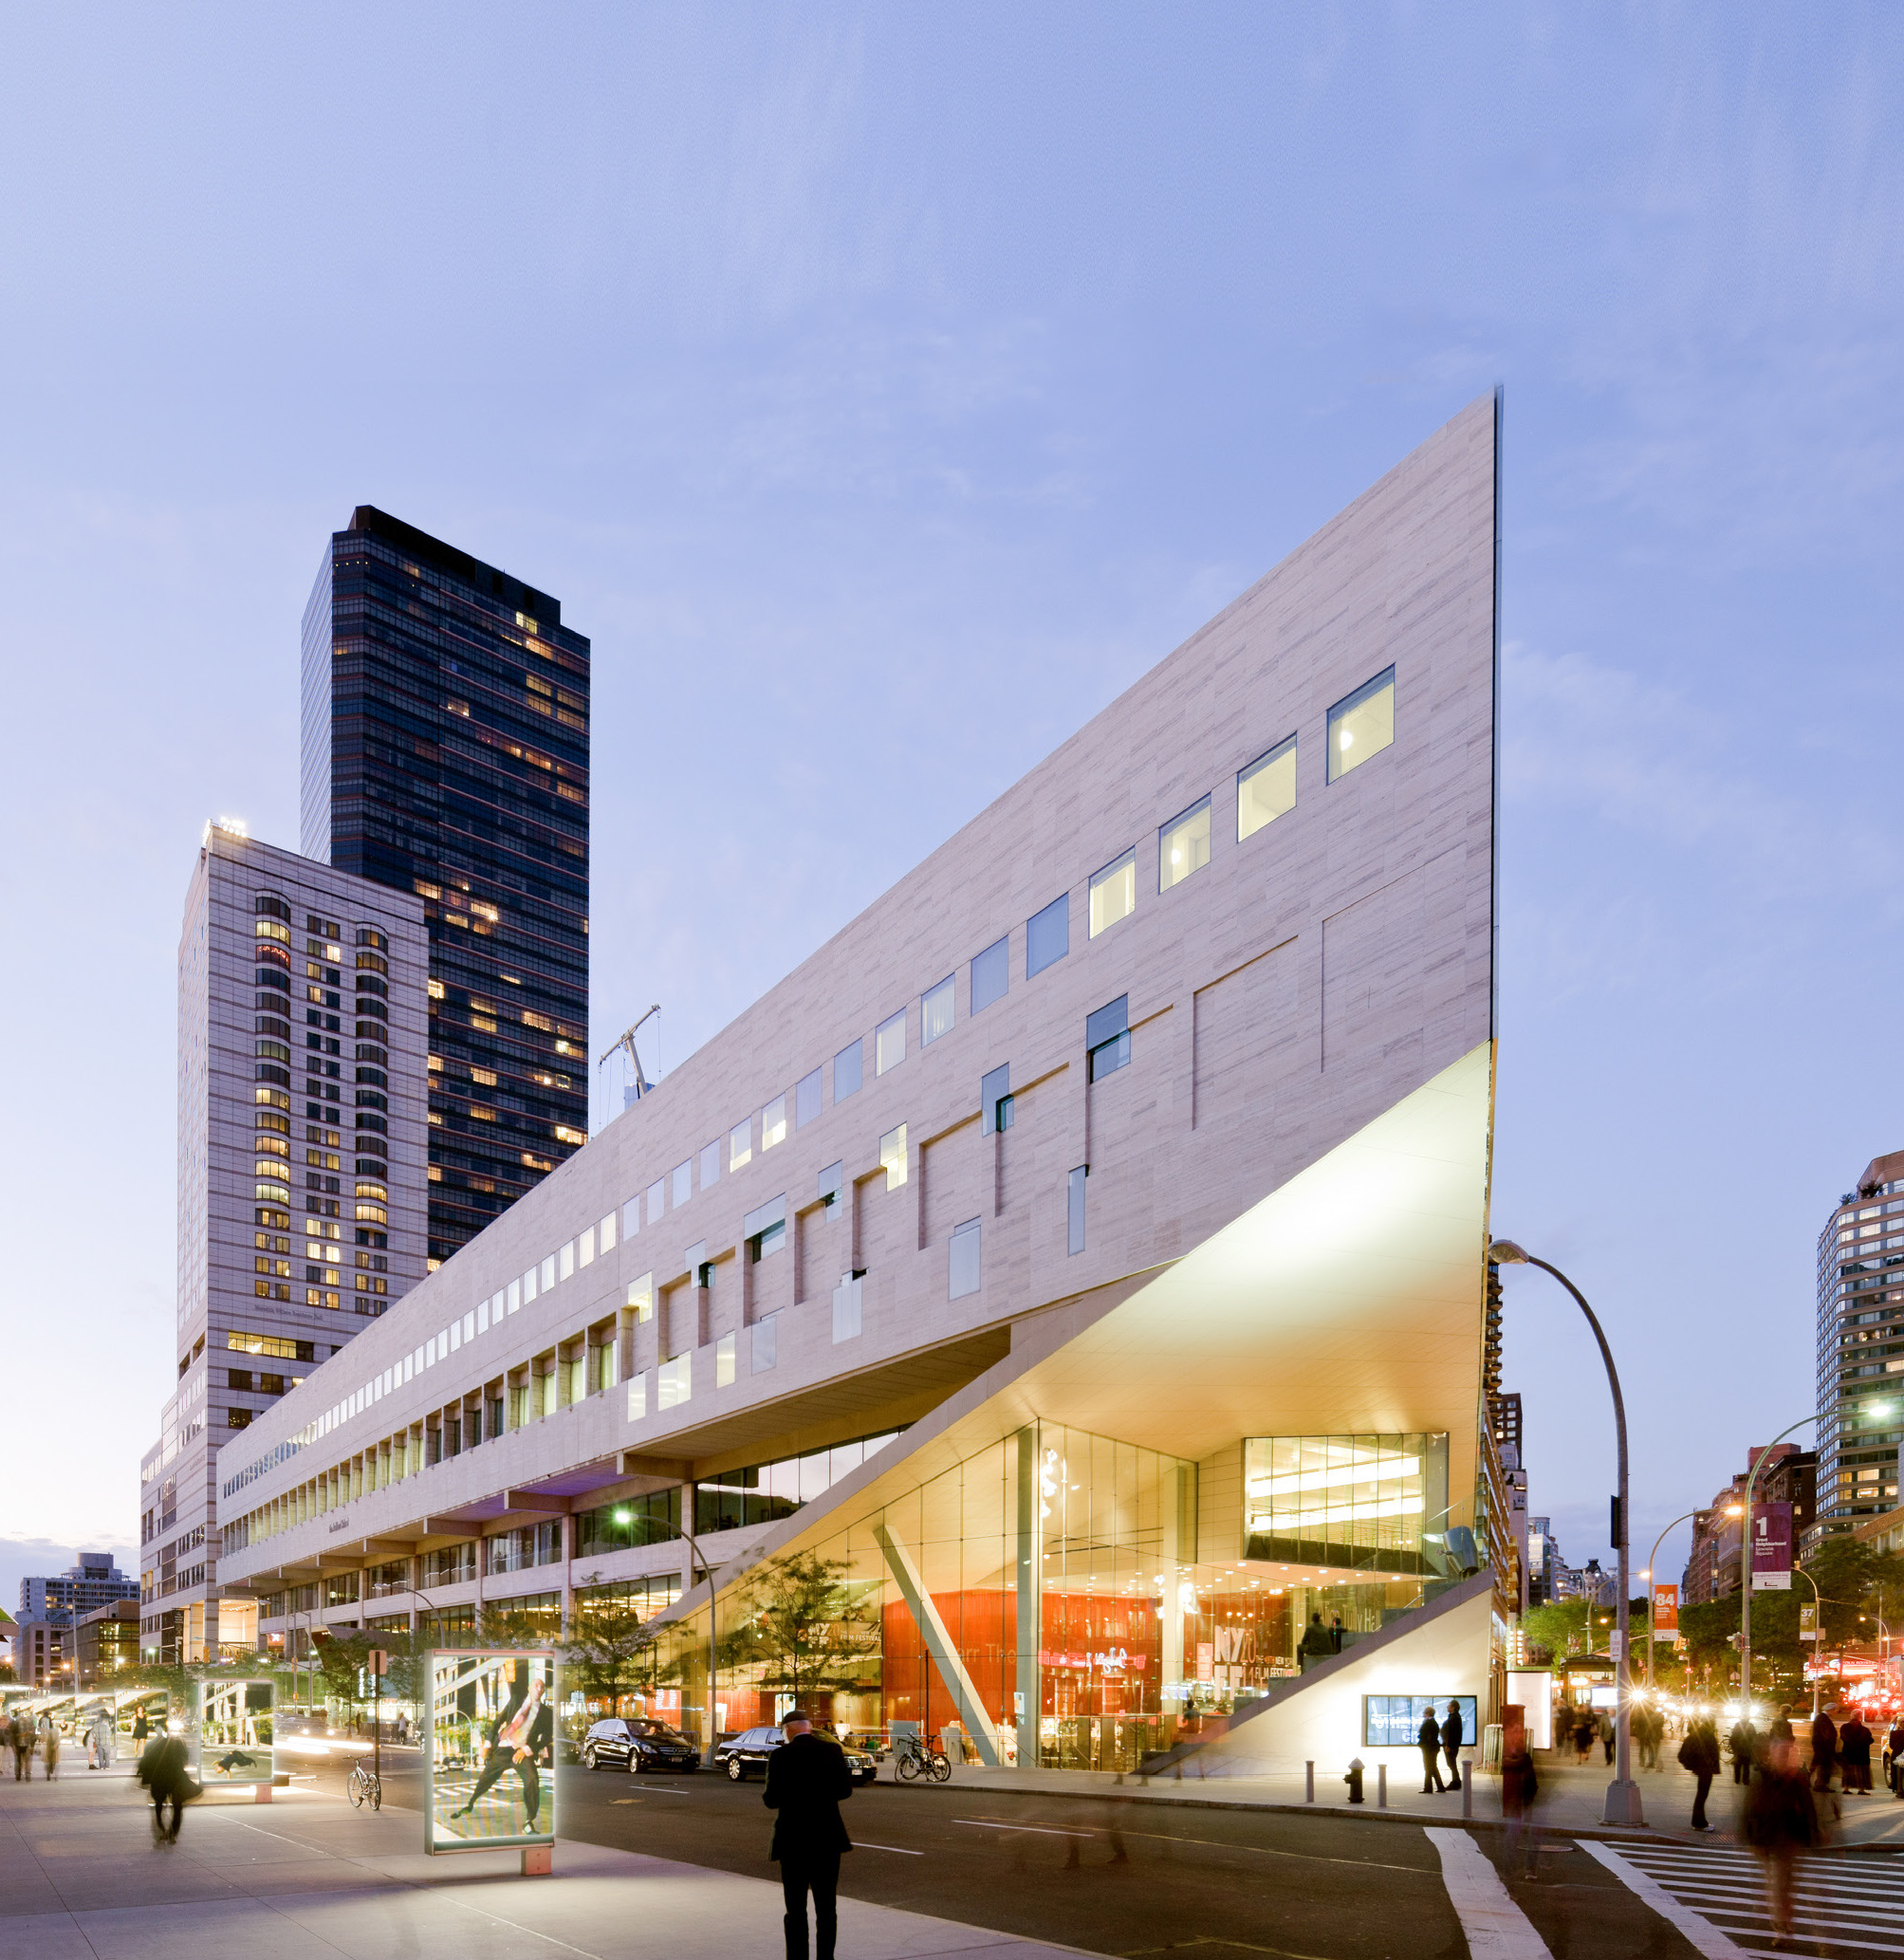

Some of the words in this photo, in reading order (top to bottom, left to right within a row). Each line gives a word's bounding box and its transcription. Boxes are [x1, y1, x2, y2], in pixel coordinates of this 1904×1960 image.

[1756, 1517, 1767, 1536] 1
[1655, 1594, 1675, 1606] 84
[1801, 1608, 1814, 1618] 37
[985, 1643, 1017, 1664] The
[1214, 1625, 1245, 1662] NY
[1240, 1629, 1256, 1664] 20
[1214, 1665, 1243, 1701] FF
